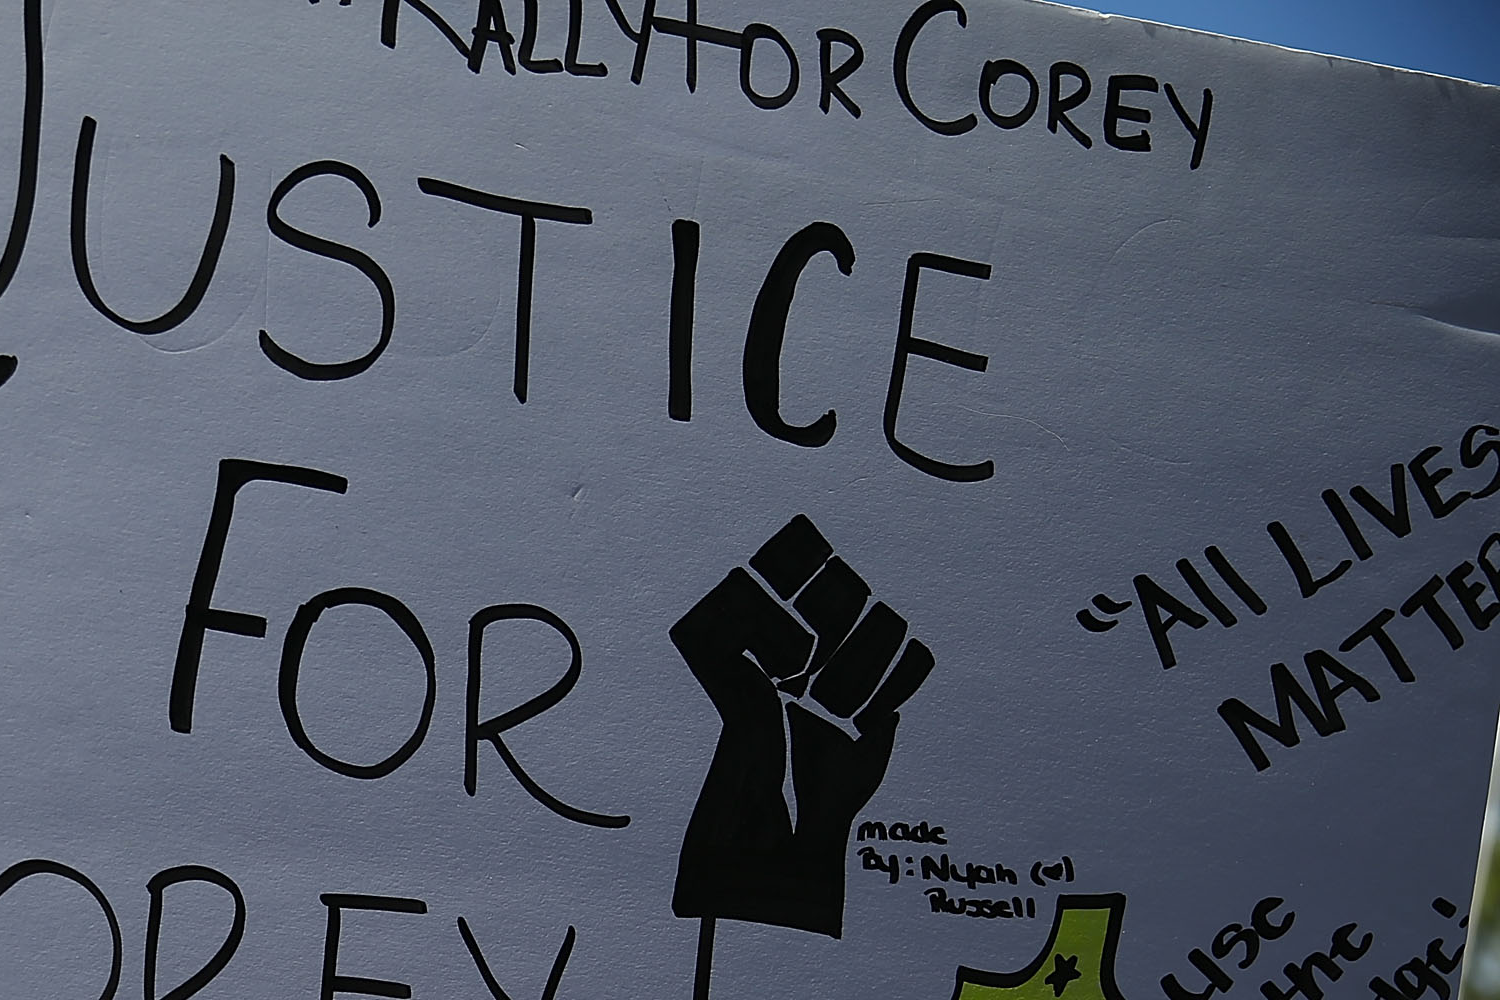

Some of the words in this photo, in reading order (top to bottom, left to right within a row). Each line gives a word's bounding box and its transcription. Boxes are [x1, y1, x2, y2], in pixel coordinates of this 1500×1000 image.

[893, 0, 1214, 170] COREY
[1266, 424, 1500, 599] LIVES
[168, 458, 632, 829] FOR
[923, 888, 1036, 919] Russell
